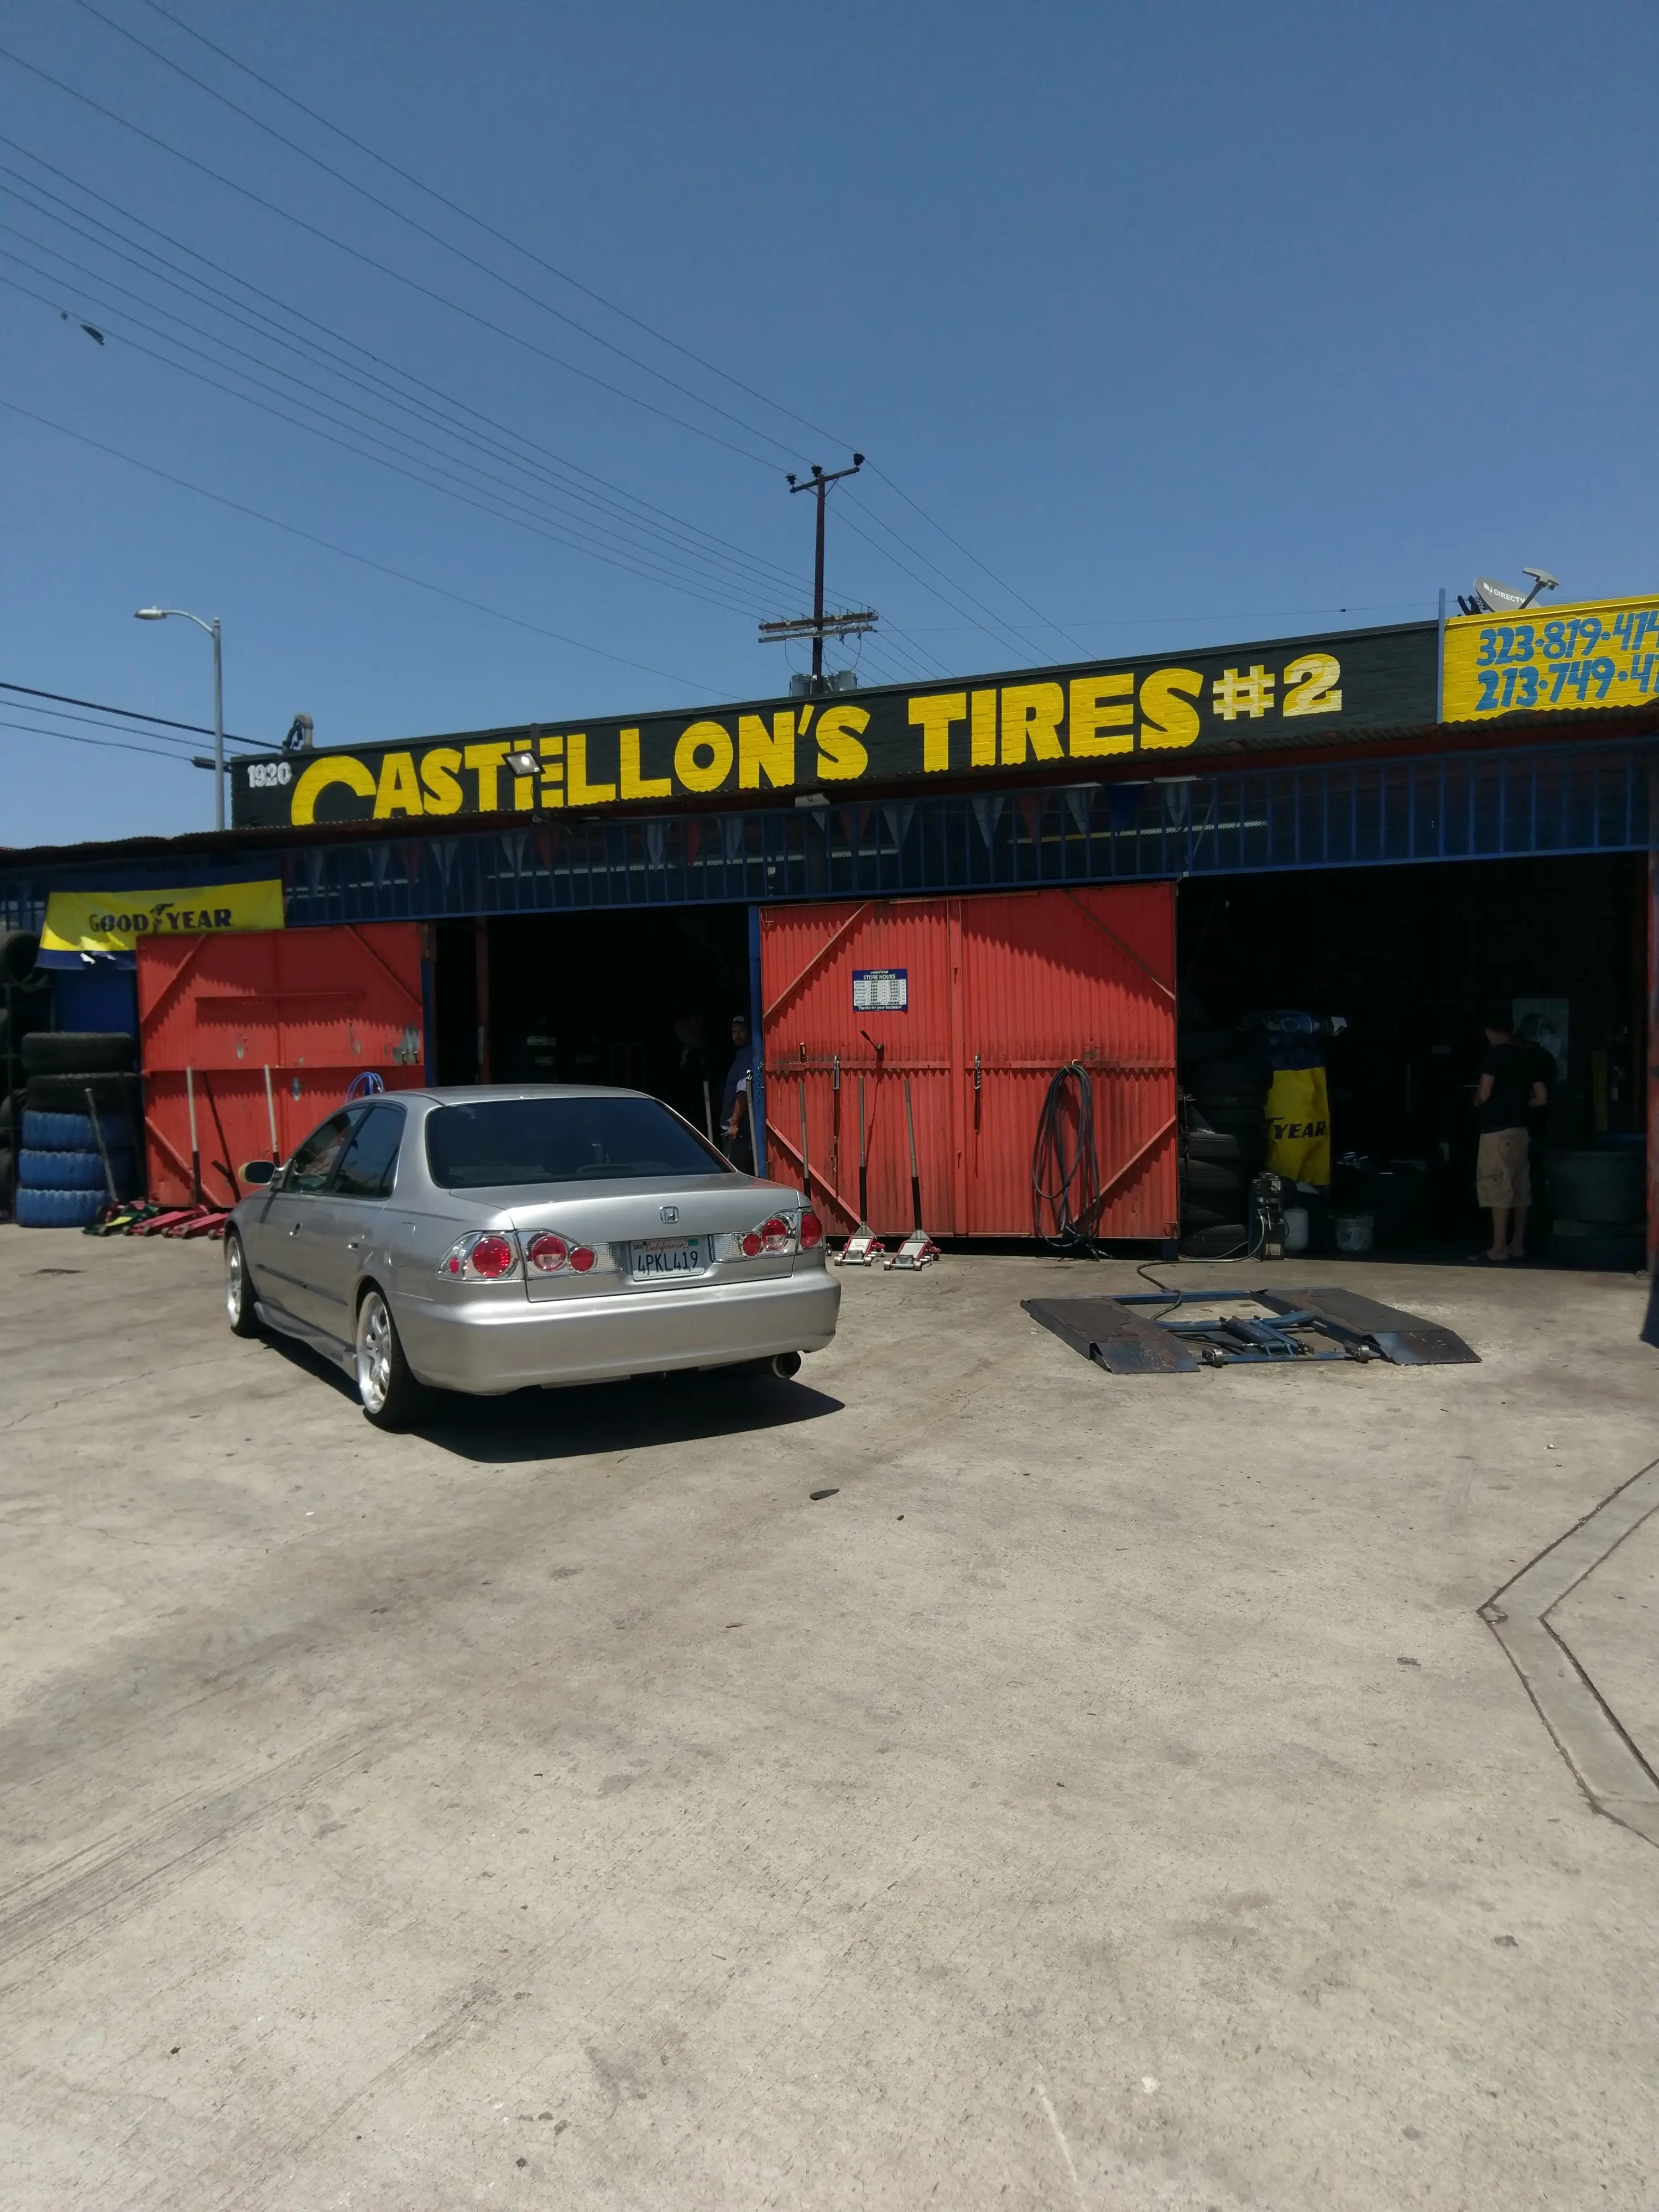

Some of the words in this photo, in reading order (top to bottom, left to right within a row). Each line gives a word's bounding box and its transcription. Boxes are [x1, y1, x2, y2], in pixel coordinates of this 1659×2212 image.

[1494, 589, 1526, 604] DIRECTV
[908, 667, 1203, 773] TIRES
[247, 761, 292, 788] 1920
[1272, 1120, 1327, 1140] YEAR
[645, 1241, 685, 1253] California
[638, 1250, 698, 1273] 4PKL419
